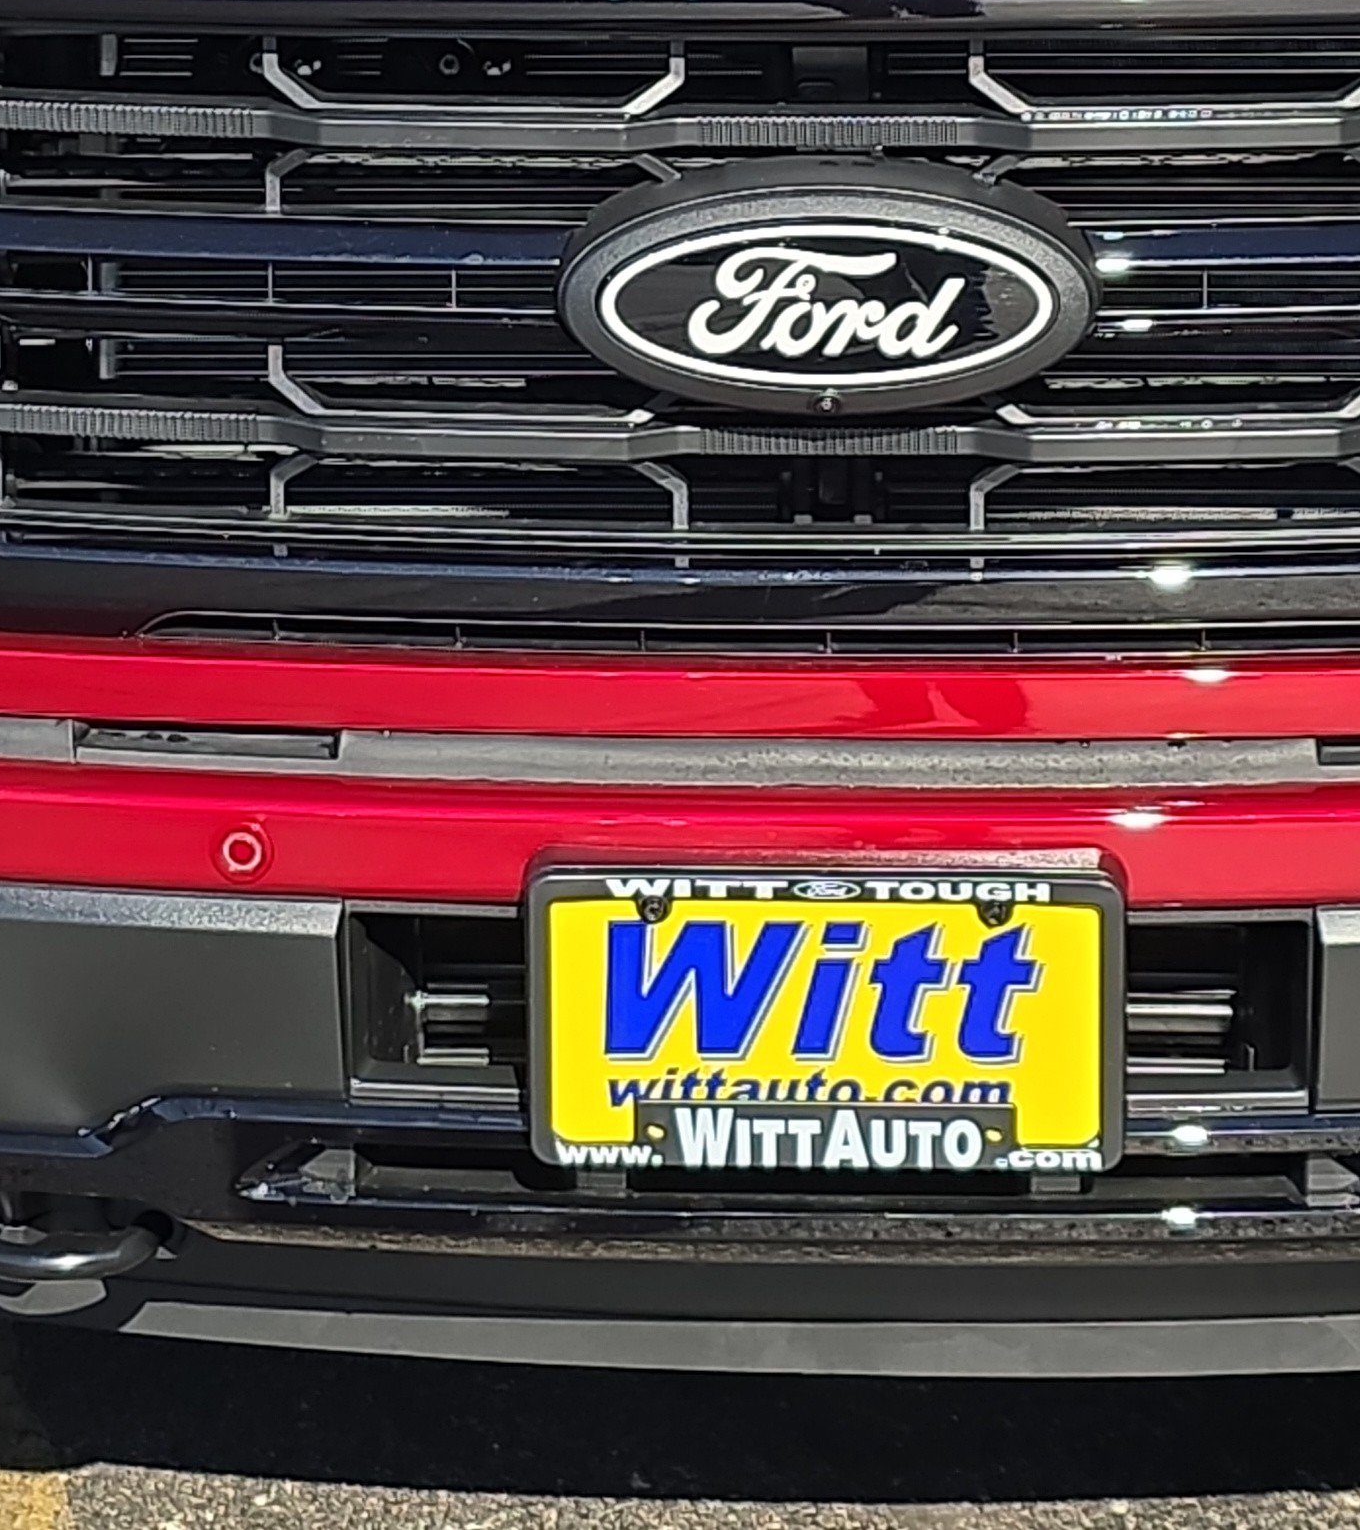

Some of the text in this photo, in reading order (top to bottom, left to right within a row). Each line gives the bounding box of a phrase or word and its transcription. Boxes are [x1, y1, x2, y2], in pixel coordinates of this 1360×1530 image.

[687, 246, 967, 359] Ford
[605, 878, 789, 899] WITT
[864, 881, 1051, 903] TOUGH
[605, 920, 1043, 1064] Witt
